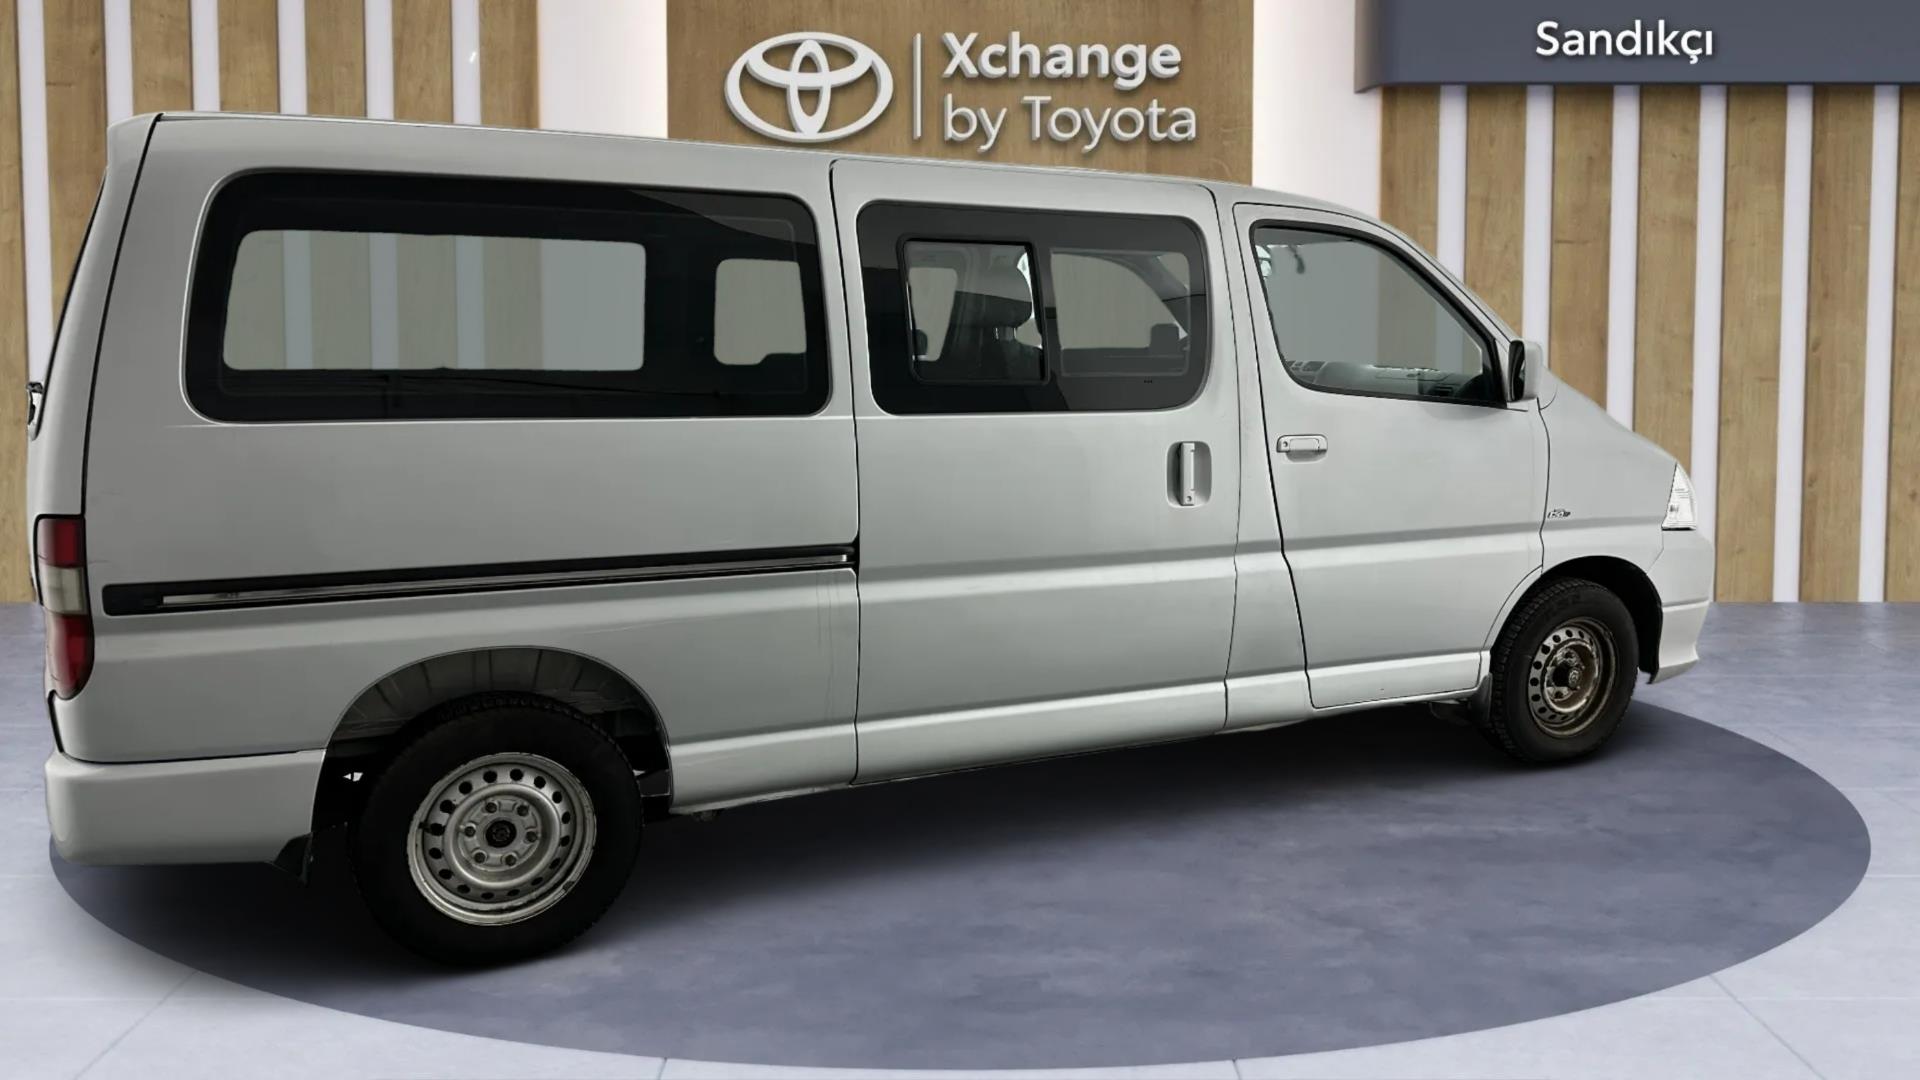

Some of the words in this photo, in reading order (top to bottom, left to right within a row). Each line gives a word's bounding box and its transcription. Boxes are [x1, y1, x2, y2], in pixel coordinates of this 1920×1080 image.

[942, 31, 1182, 91] Xchange
[1536, 19, 1713, 65] Sandıkçı
[944, 93, 1007, 153] by
[1021, 95, 1197, 154] Toyota
